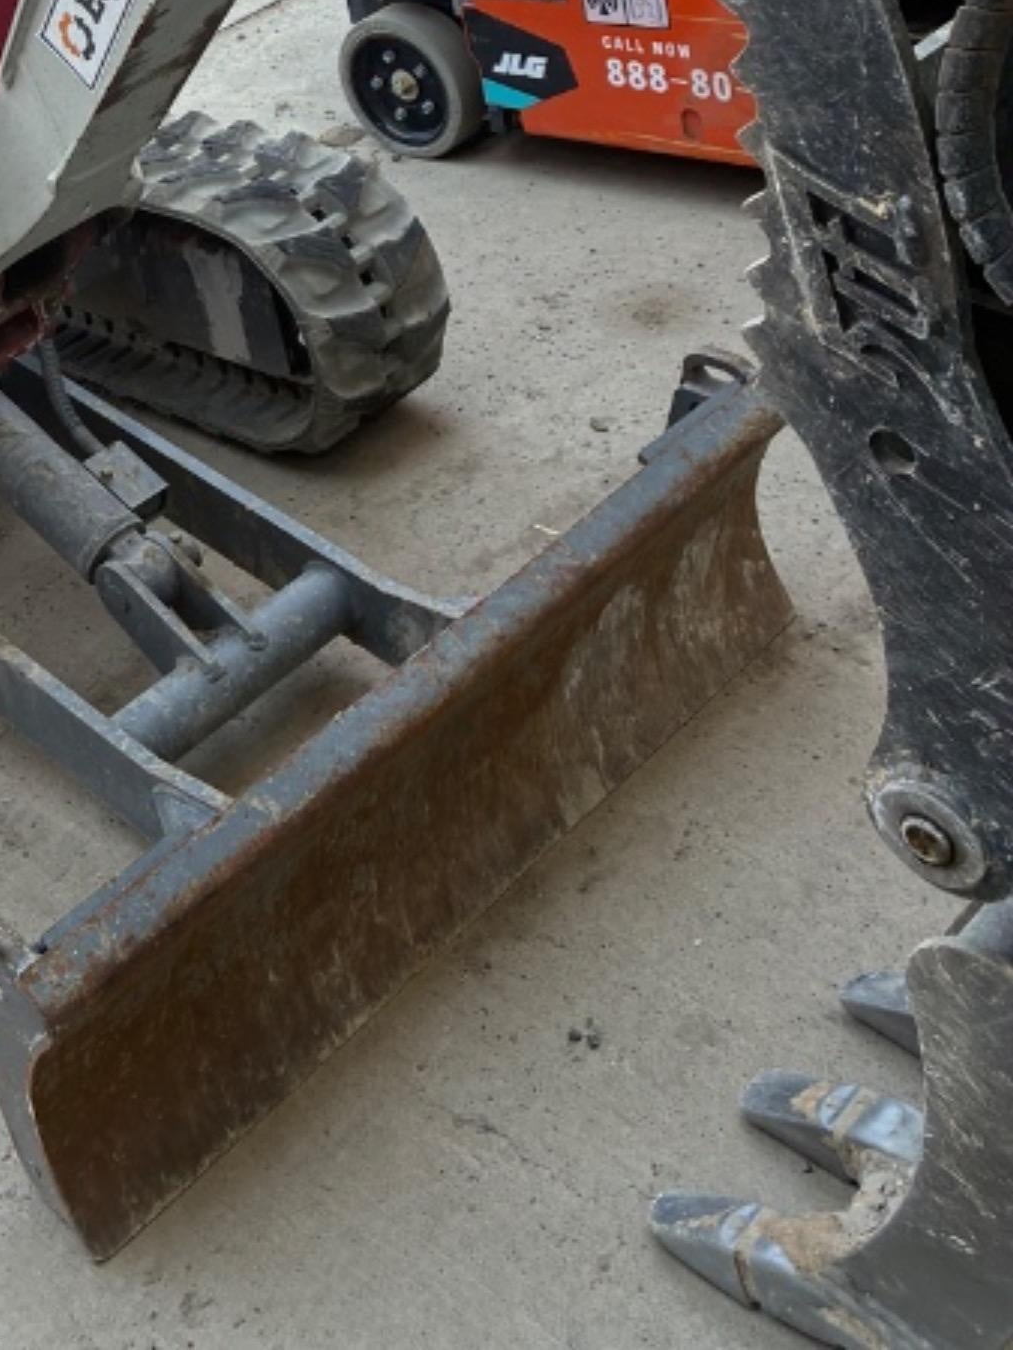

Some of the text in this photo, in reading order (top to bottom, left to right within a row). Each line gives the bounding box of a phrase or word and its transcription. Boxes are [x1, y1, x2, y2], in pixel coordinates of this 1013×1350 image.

[601, 35, 691, 58] CALL NOW
[492, 52, 549, 79] JLG
[606, 57, 743, 102] 888-80
